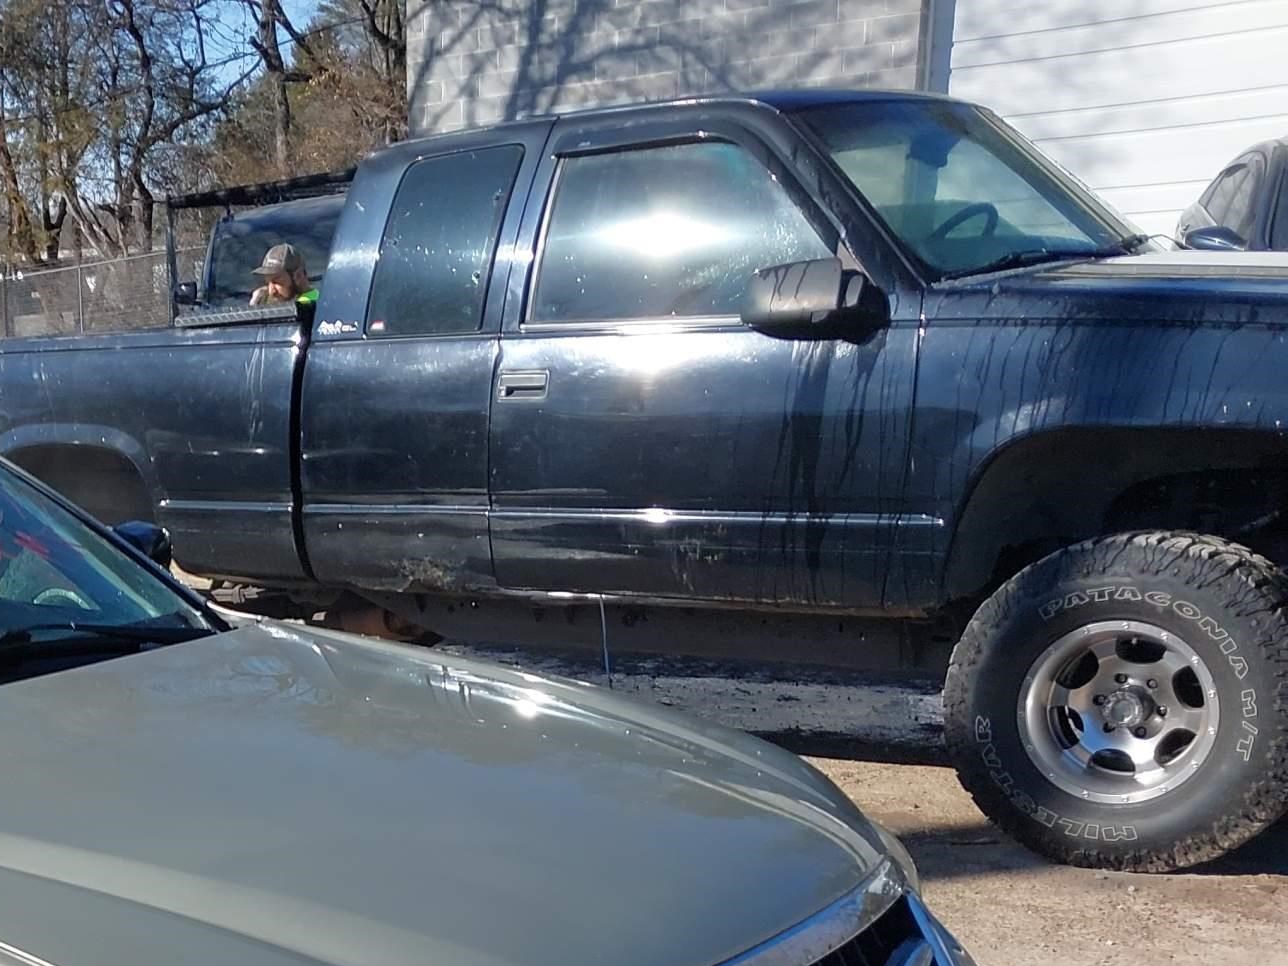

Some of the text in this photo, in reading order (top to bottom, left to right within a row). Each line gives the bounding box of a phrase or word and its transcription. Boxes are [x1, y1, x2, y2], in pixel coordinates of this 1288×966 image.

[1038, 585, 1260, 761] PATAGONIA M/T
[974, 714, 1138, 842] MILESTAR
